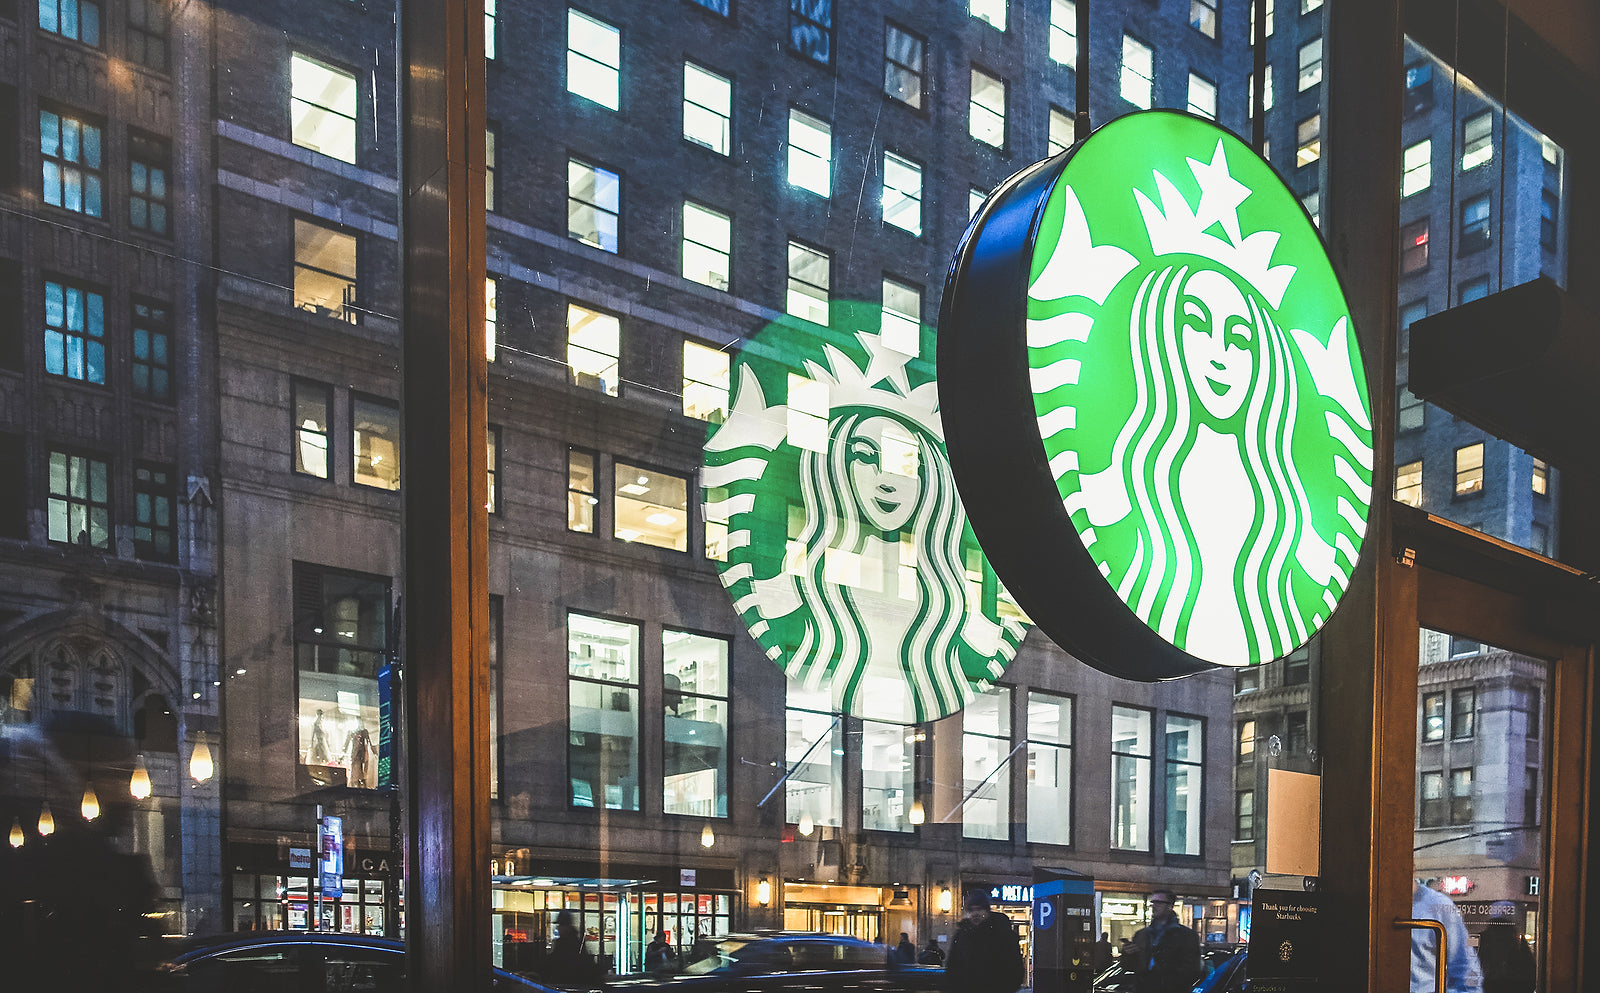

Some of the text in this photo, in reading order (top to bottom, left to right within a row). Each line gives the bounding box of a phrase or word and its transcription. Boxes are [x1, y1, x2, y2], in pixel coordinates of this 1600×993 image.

[1040, 902, 1052, 926] P
[1262, 902, 1278, 911] Thank
[1279, 905, 1288, 913] you
[1297, 905, 1317, 914] choosing
